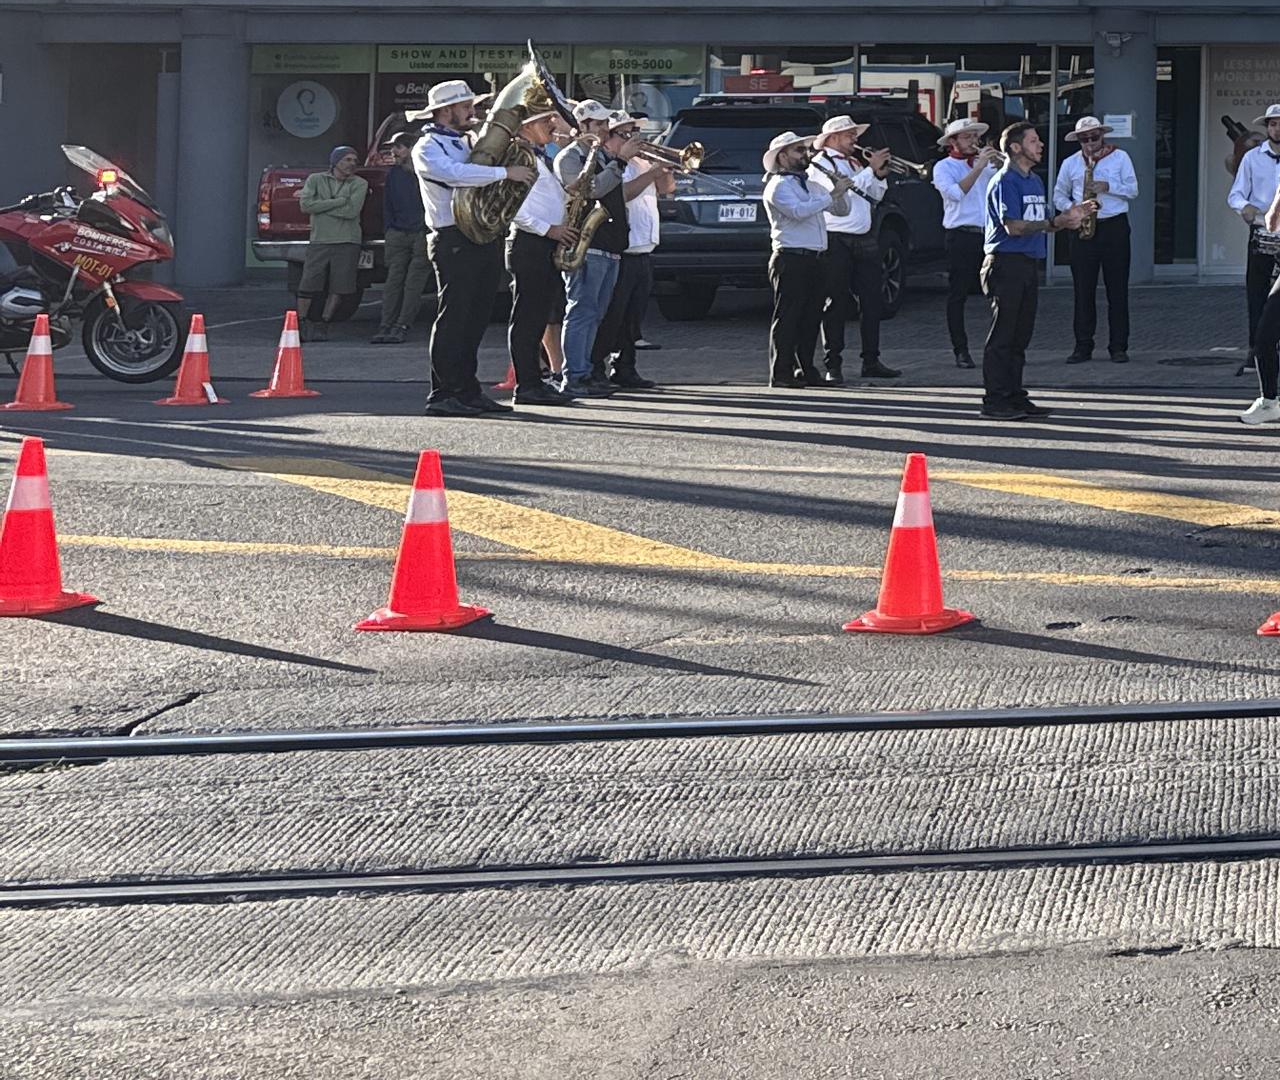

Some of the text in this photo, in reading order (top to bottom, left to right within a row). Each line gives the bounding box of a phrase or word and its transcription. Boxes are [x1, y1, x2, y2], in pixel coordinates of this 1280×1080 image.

[391, 50, 562, 59] SHOW AND TEST ROM
[409, 61, 435, 69] Usted
[609, 59, 672, 70] 8589-5000
[1216, 89, 1260, 97] BELLEZA
[76, 225, 133, 250] BOMBEROS
[73, 237, 128, 258] COSTA RICA
[73, 254, 114, 278] MOT-01
